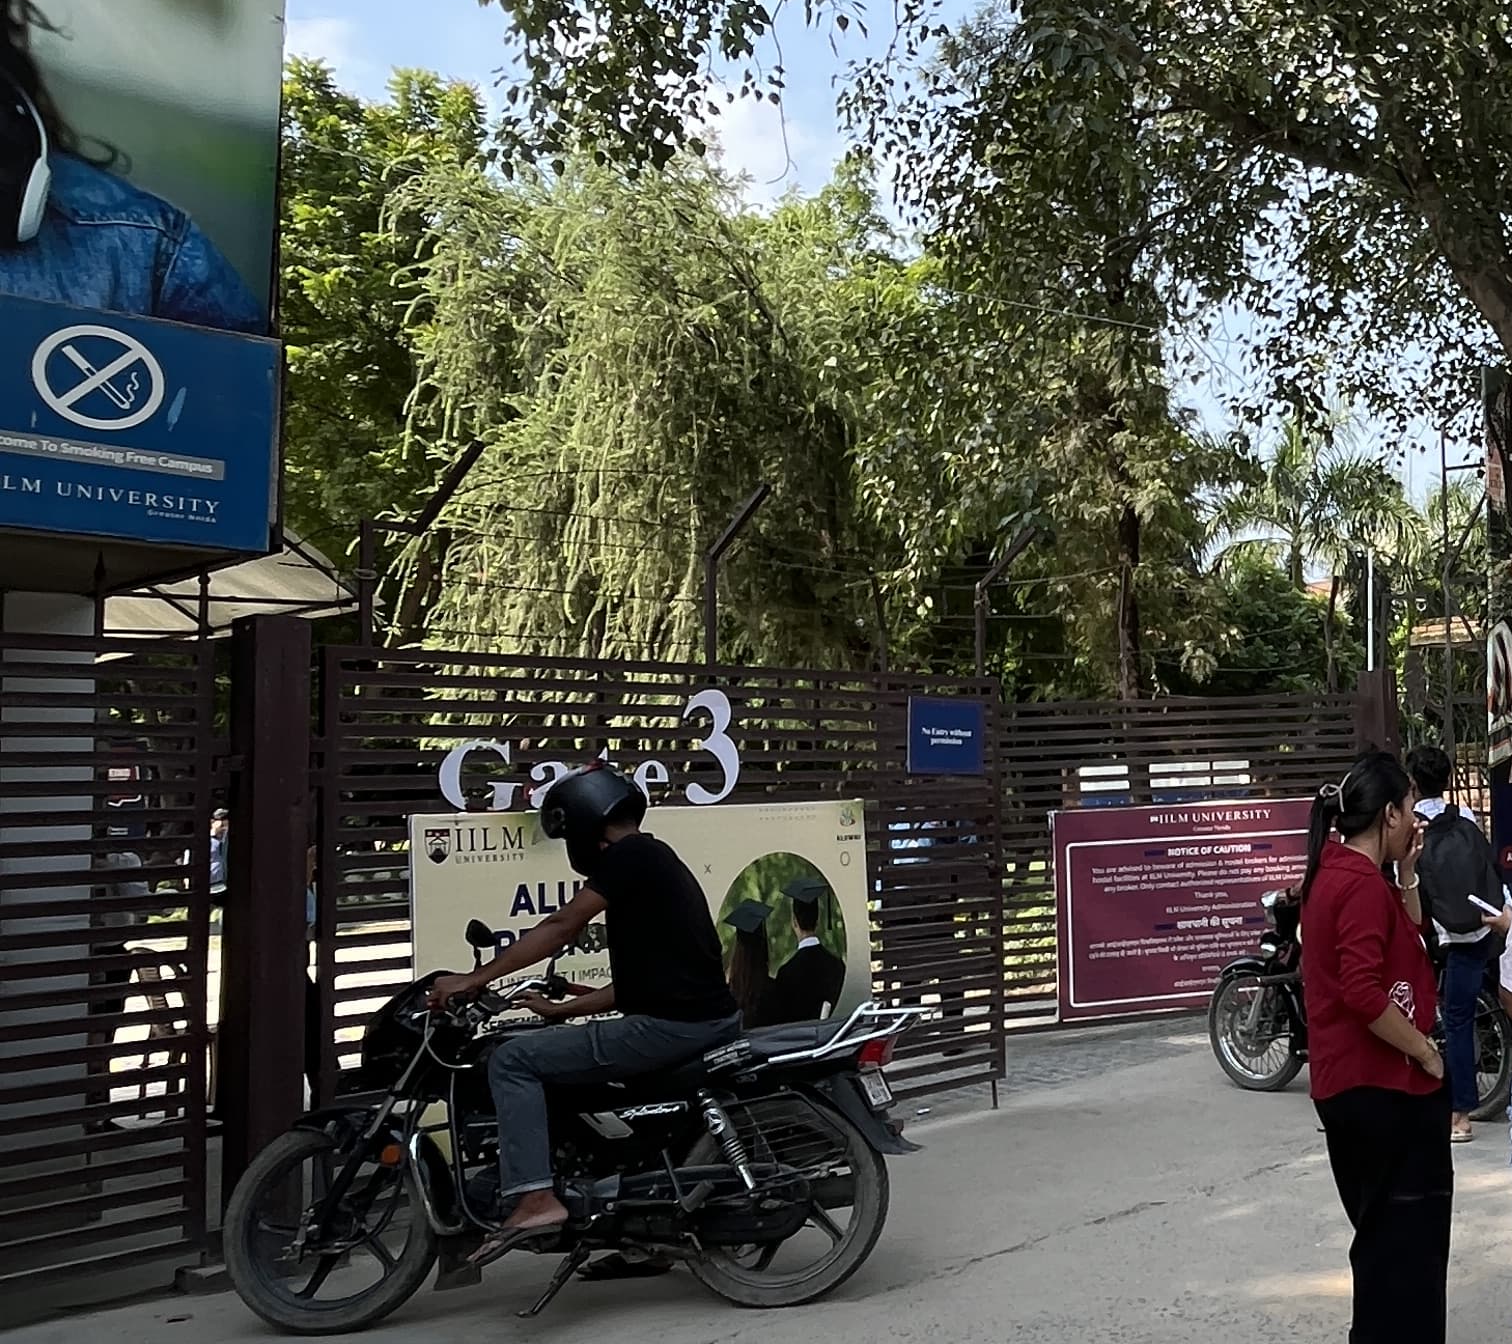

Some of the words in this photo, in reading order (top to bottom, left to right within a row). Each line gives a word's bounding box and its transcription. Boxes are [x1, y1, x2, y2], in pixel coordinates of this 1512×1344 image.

[0, 436, 38, 449] come
[40, 440, 58, 452] To
[60, 443, 124, 464] Smoking
[126, 452, 156, 465] Free
[158, 457, 213, 473] Campus
[3, 475, 41, 493] LM
[57, 482, 220, 514] UNIVERSITY
[438, 739, 669, 812] Gae
[682, 689, 740, 804] 3
[1159, 813, 1188, 824] IILM
[1192, 809, 1271, 822] UNIVERSITY
[455, 827, 525, 852] IILM
[455, 852, 524, 864] UNIVERSITY
[1168, 846, 1199, 856] NOTICE
[1200, 846, 1212, 855] OF
[1213, 844, 1251, 854] CAUTION
[579, 967, 611, 981] IMPAC
